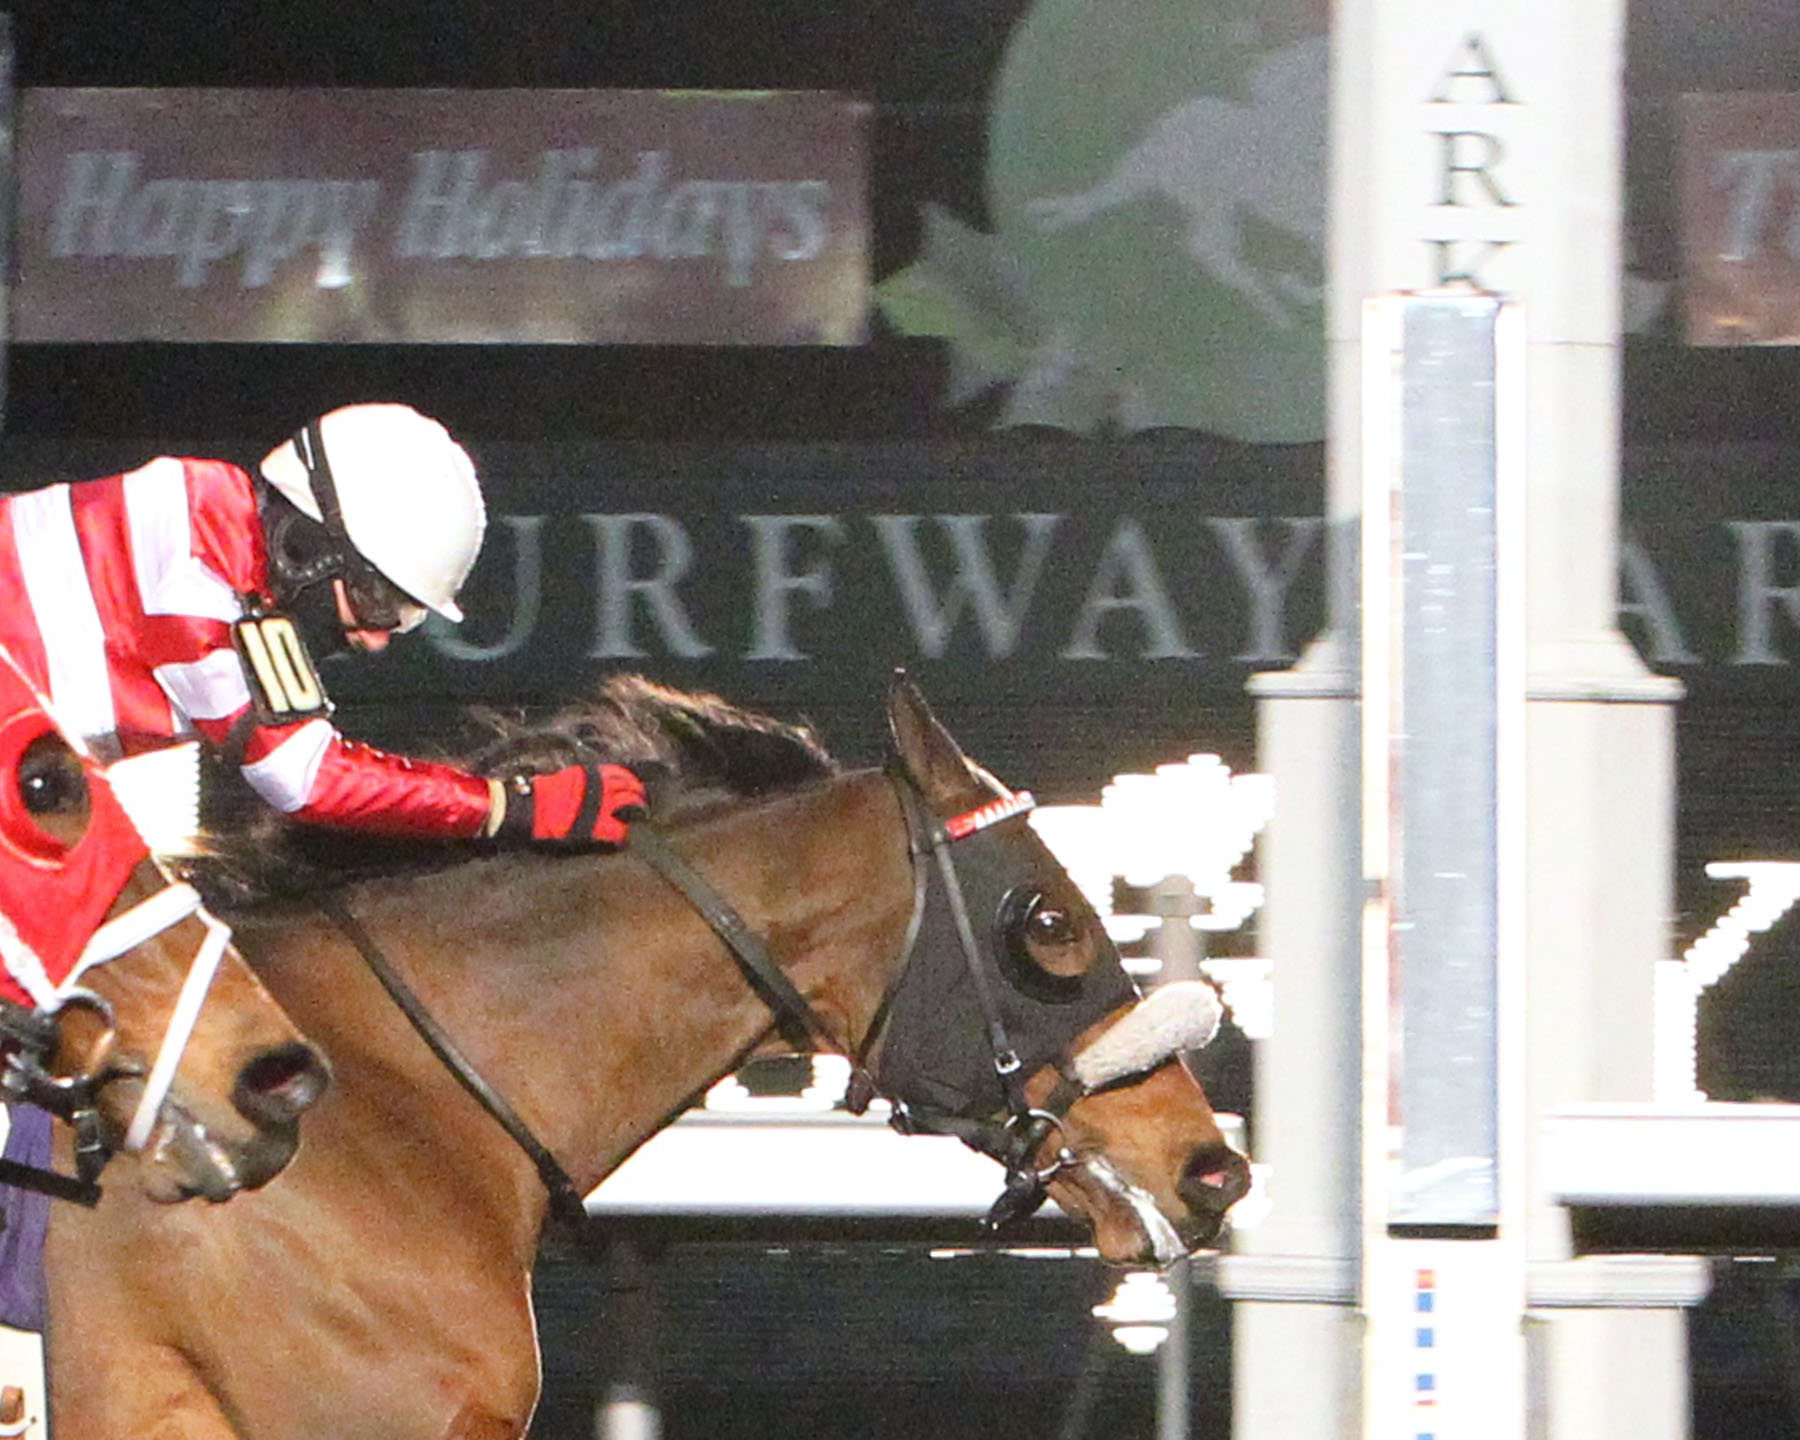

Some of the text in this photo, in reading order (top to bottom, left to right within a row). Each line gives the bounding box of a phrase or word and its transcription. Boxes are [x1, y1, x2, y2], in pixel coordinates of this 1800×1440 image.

[49, 149, 833, 288] Happy Holidays
[324, 512, 1333, 663] URFWAY
[238, 616, 322, 713] 10
